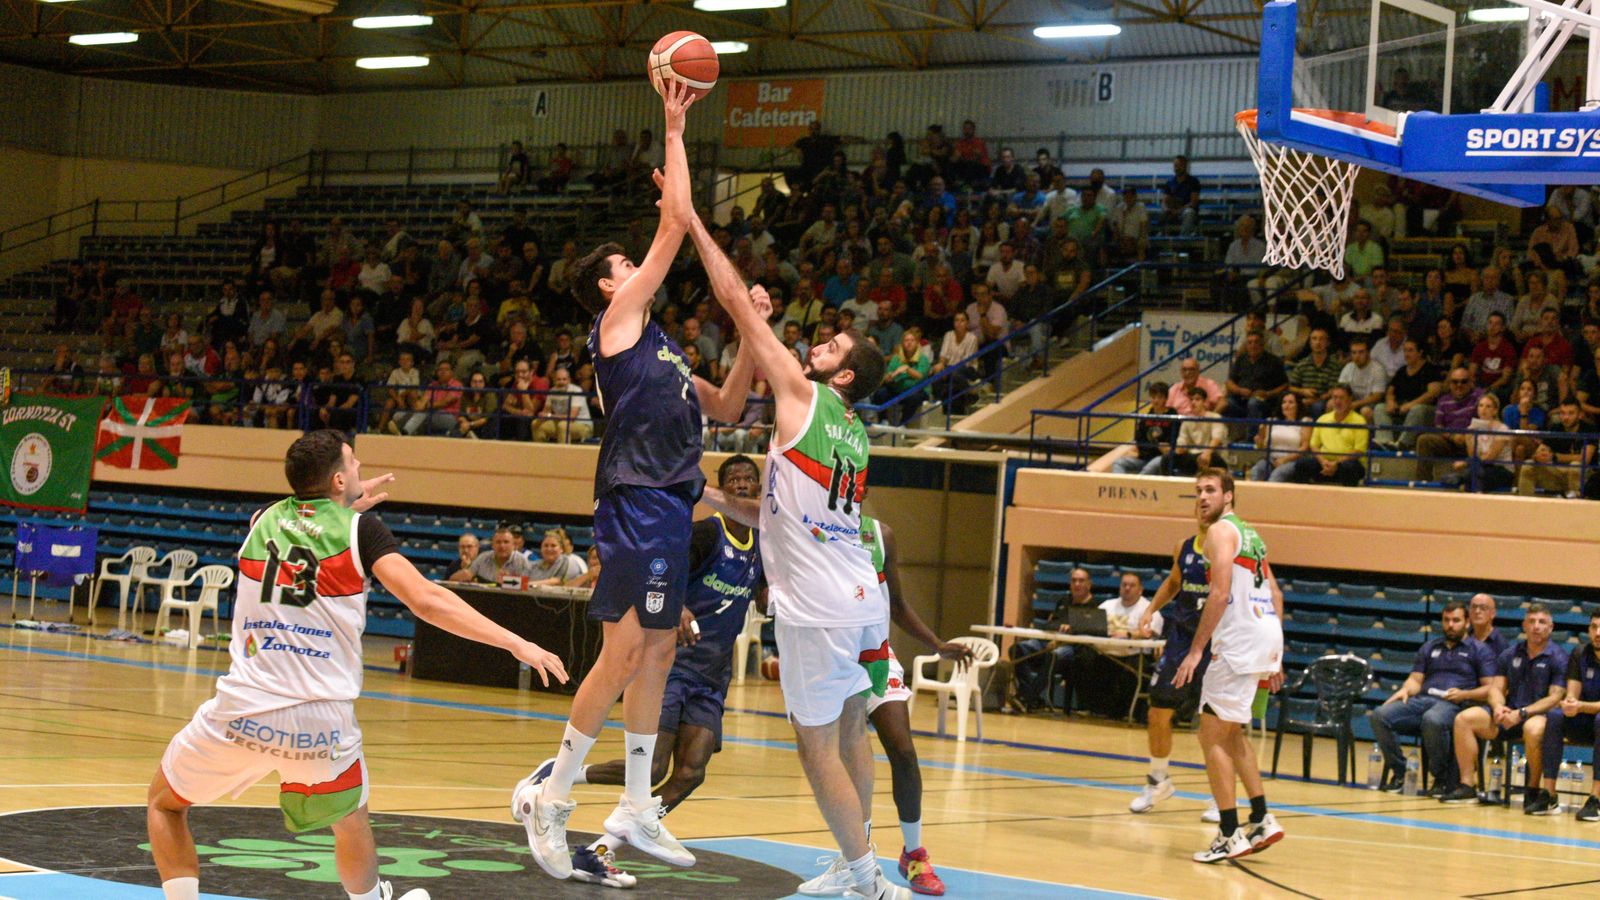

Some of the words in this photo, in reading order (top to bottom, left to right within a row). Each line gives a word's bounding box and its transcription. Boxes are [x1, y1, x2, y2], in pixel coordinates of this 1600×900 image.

[758, 82, 793, 103] Bar
[1098, 72, 1112, 102] B
[535, 91, 546, 115] A
[2, 405, 63, 425] ZORNOTZA
[59, 413, 77, 432] ST
[828, 445, 857, 515] 11
[1097, 485, 1159, 501] PRENSA
[259, 538, 321, 608] 13
[714, 599, 733, 615] 7
[243, 616, 333, 639] Instalaciones
[260, 636, 331, 660] Zornotza
[228, 716, 341, 750] BEOTIBAR
